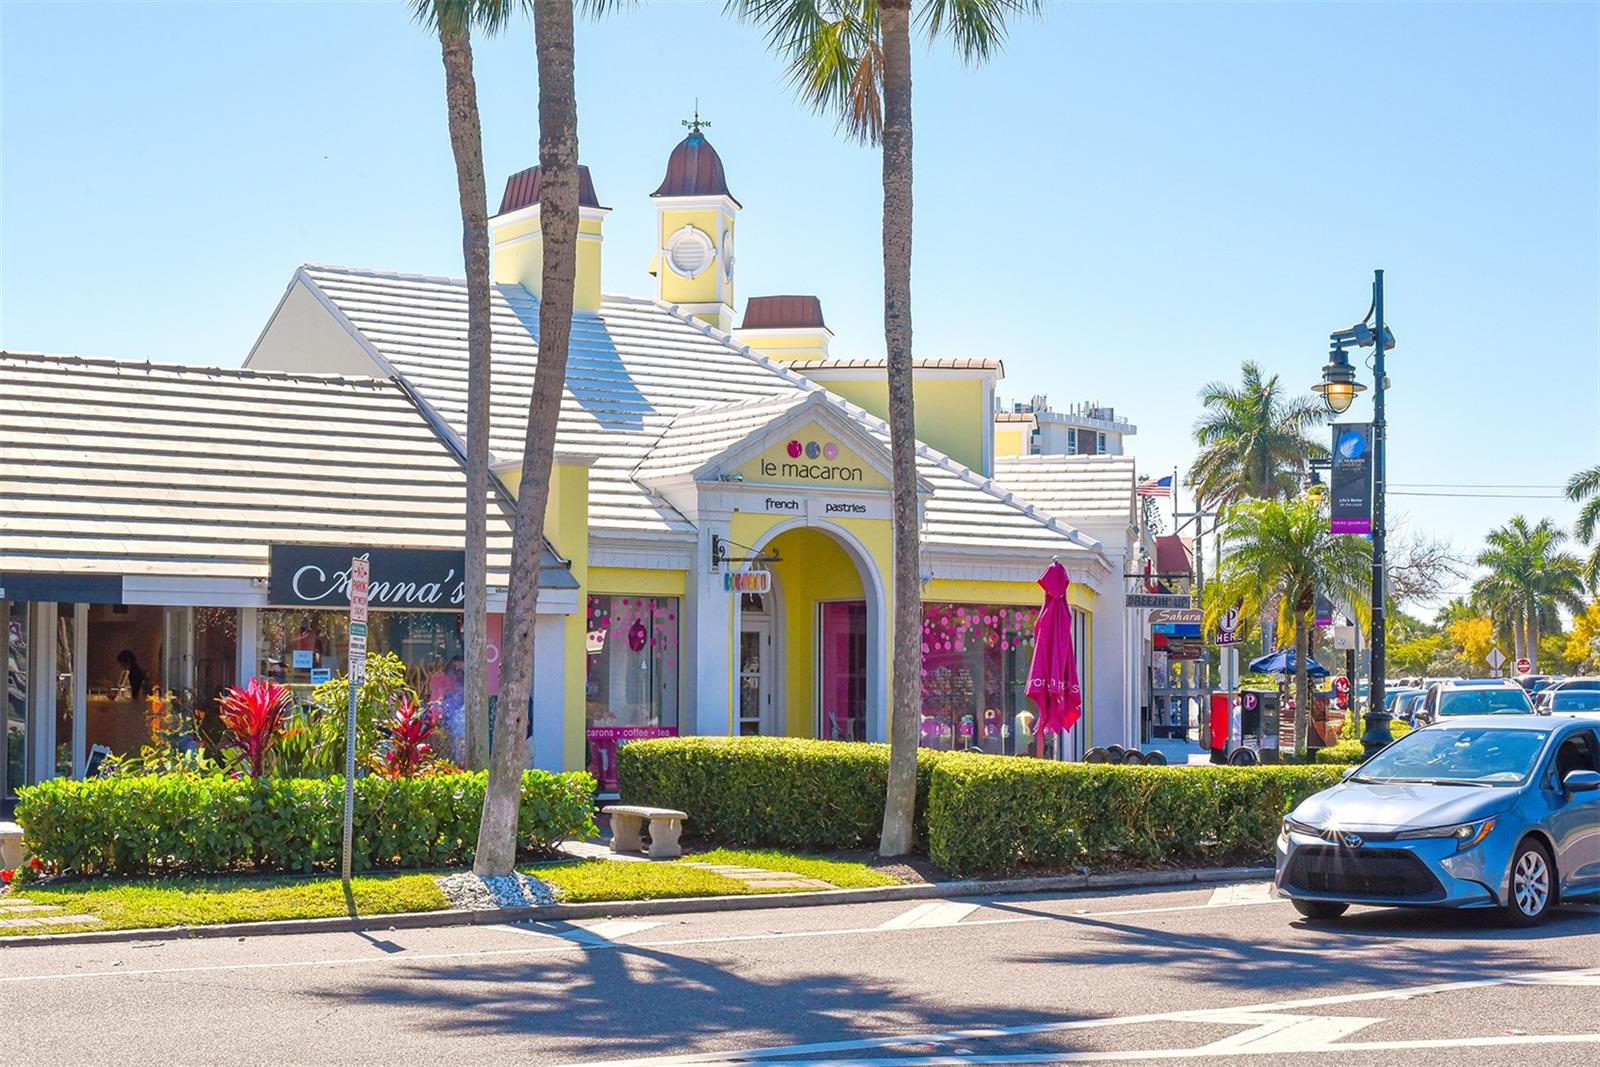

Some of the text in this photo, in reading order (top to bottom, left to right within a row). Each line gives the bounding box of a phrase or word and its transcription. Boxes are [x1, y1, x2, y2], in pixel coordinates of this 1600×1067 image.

[761, 458, 863, 482] le macaron
[765, 497, 867, 514] french pastries
[1128, 595, 1189, 608] BREEZIN' UP
[1159, 610, 1200, 622] Sahara
[1246, 694, 1256, 709] P
[623, 728, 649, 737] coffee
[657, 729, 670, 737] tea
